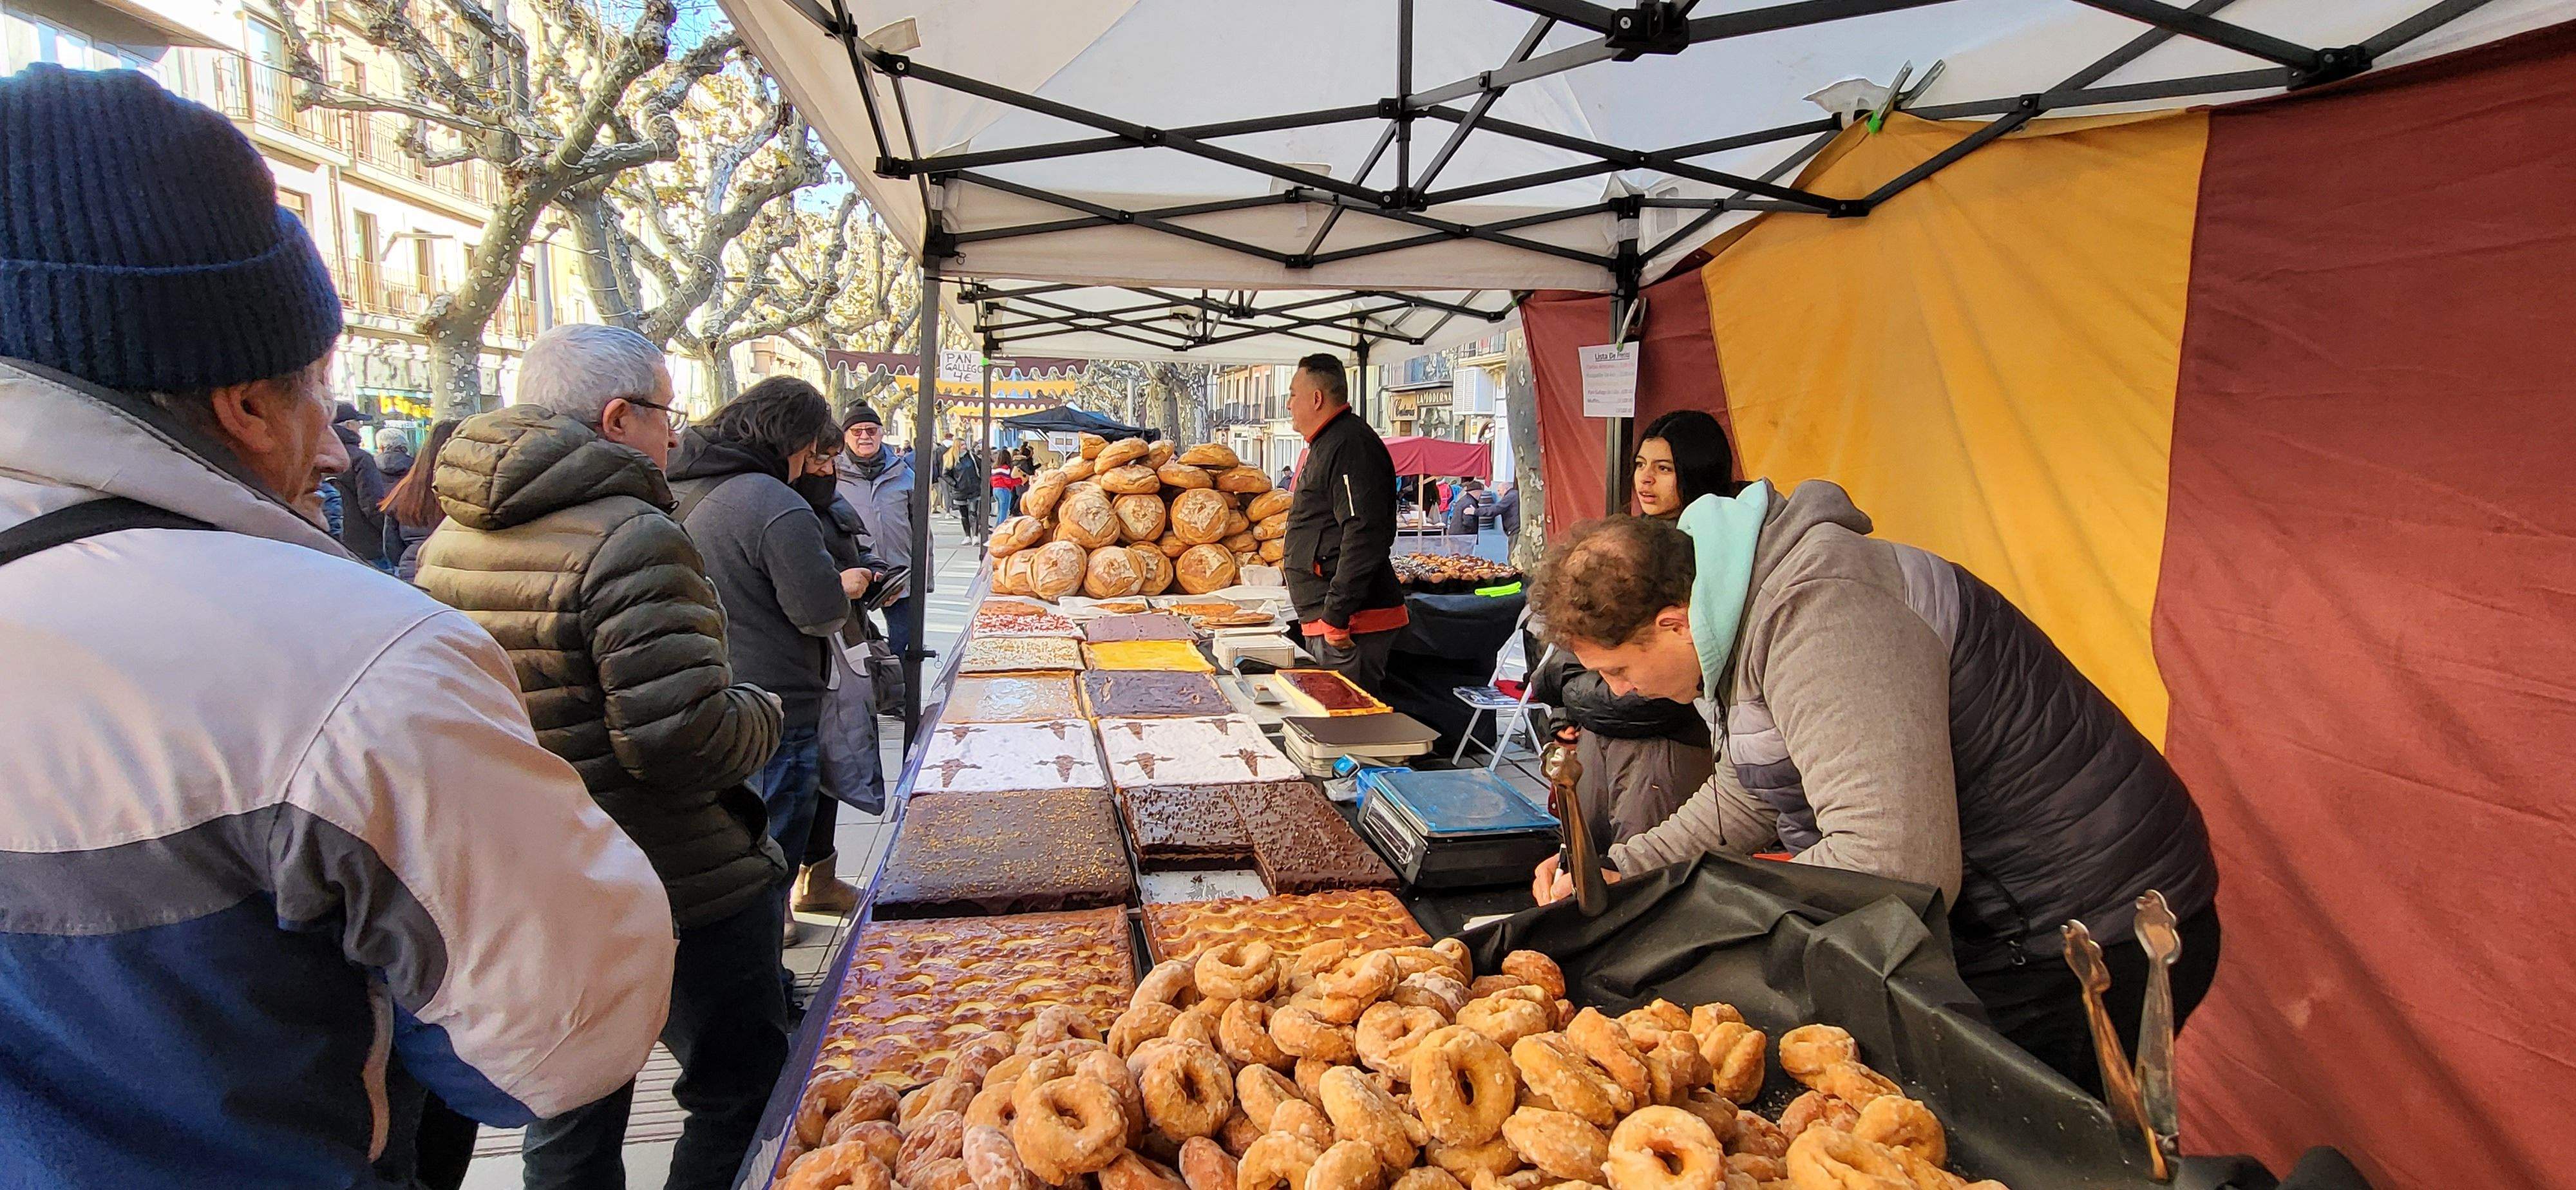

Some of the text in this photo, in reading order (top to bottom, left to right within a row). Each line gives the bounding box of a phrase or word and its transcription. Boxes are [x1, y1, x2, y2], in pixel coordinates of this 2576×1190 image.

[946, 353, 971, 363] PAN
[945, 363, 984, 373] GALLEGO
[953, 372, 971, 382] 4€
[1417, 391, 1452, 404] LA MODERNA
